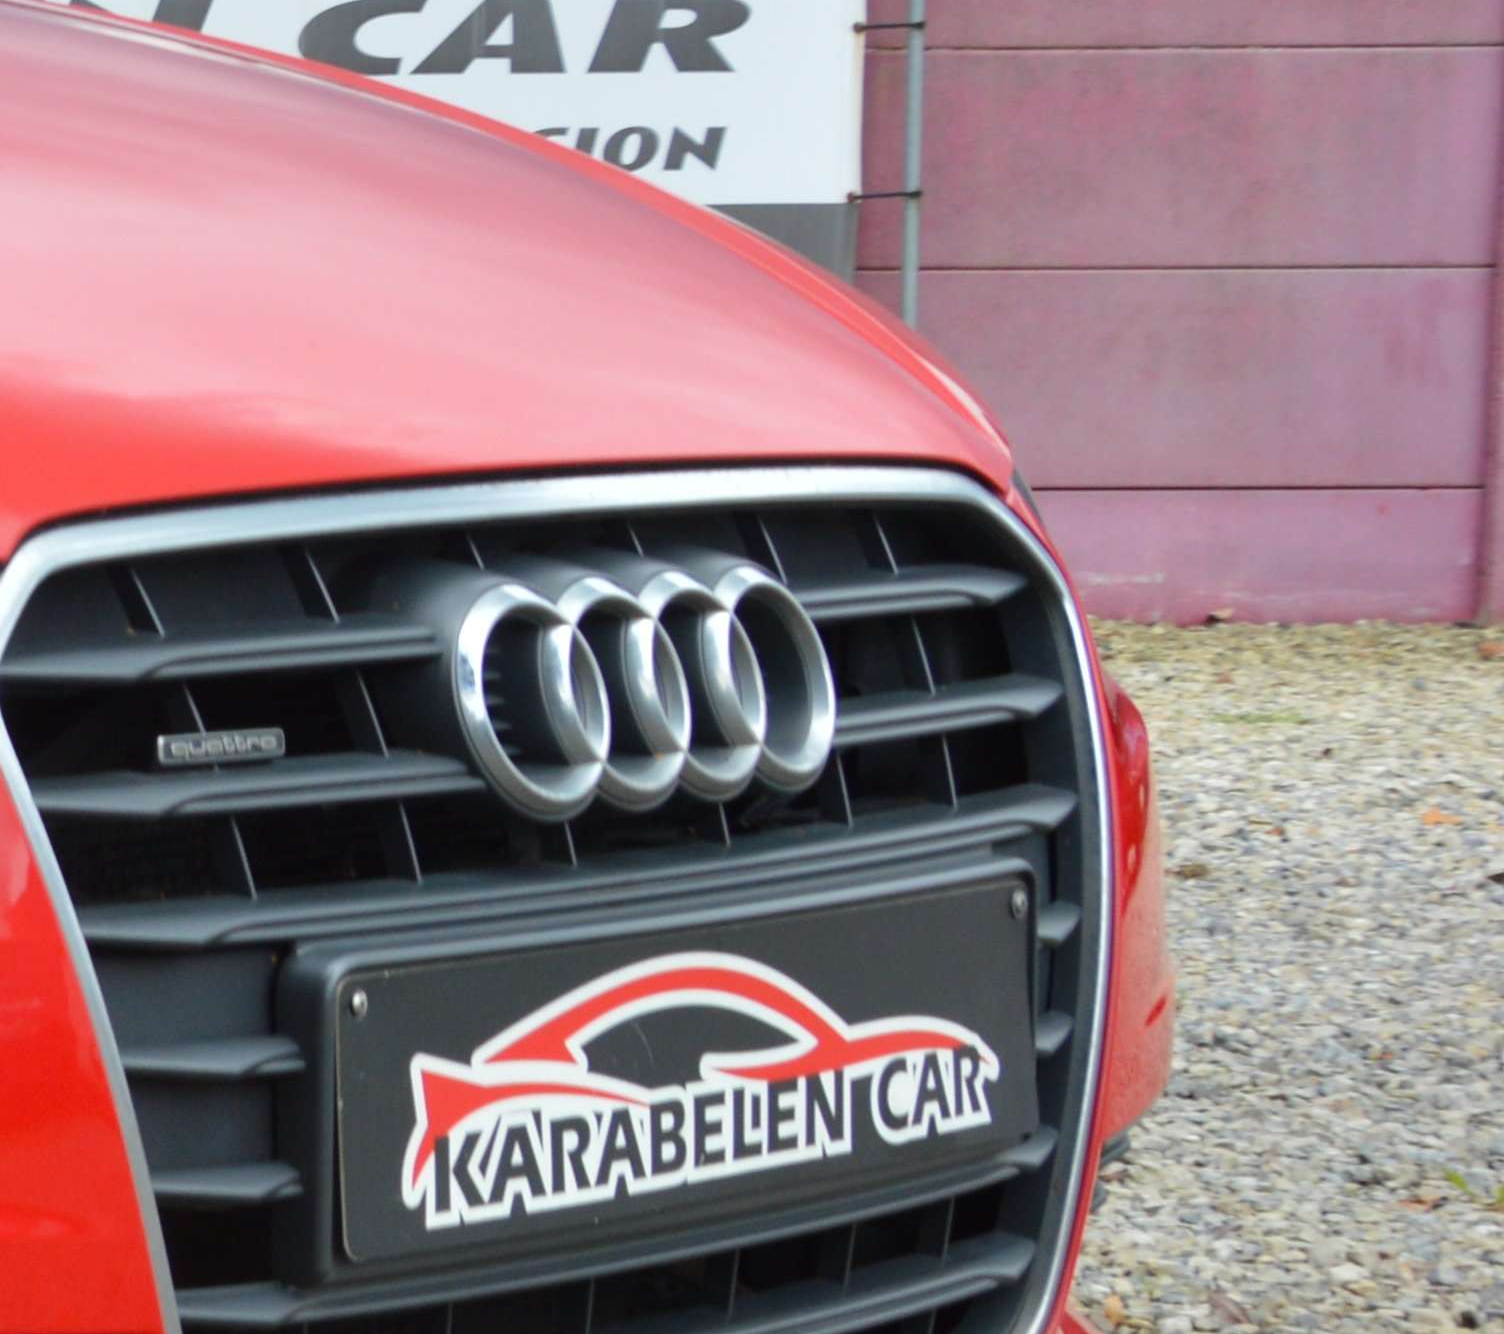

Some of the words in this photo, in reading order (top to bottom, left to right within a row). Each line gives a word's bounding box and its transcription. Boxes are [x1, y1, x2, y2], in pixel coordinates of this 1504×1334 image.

[170, 733, 278, 762] quattro
[432, 1067, 846, 1215] KARABELEN
[876, 1043, 990, 1131] CAR
